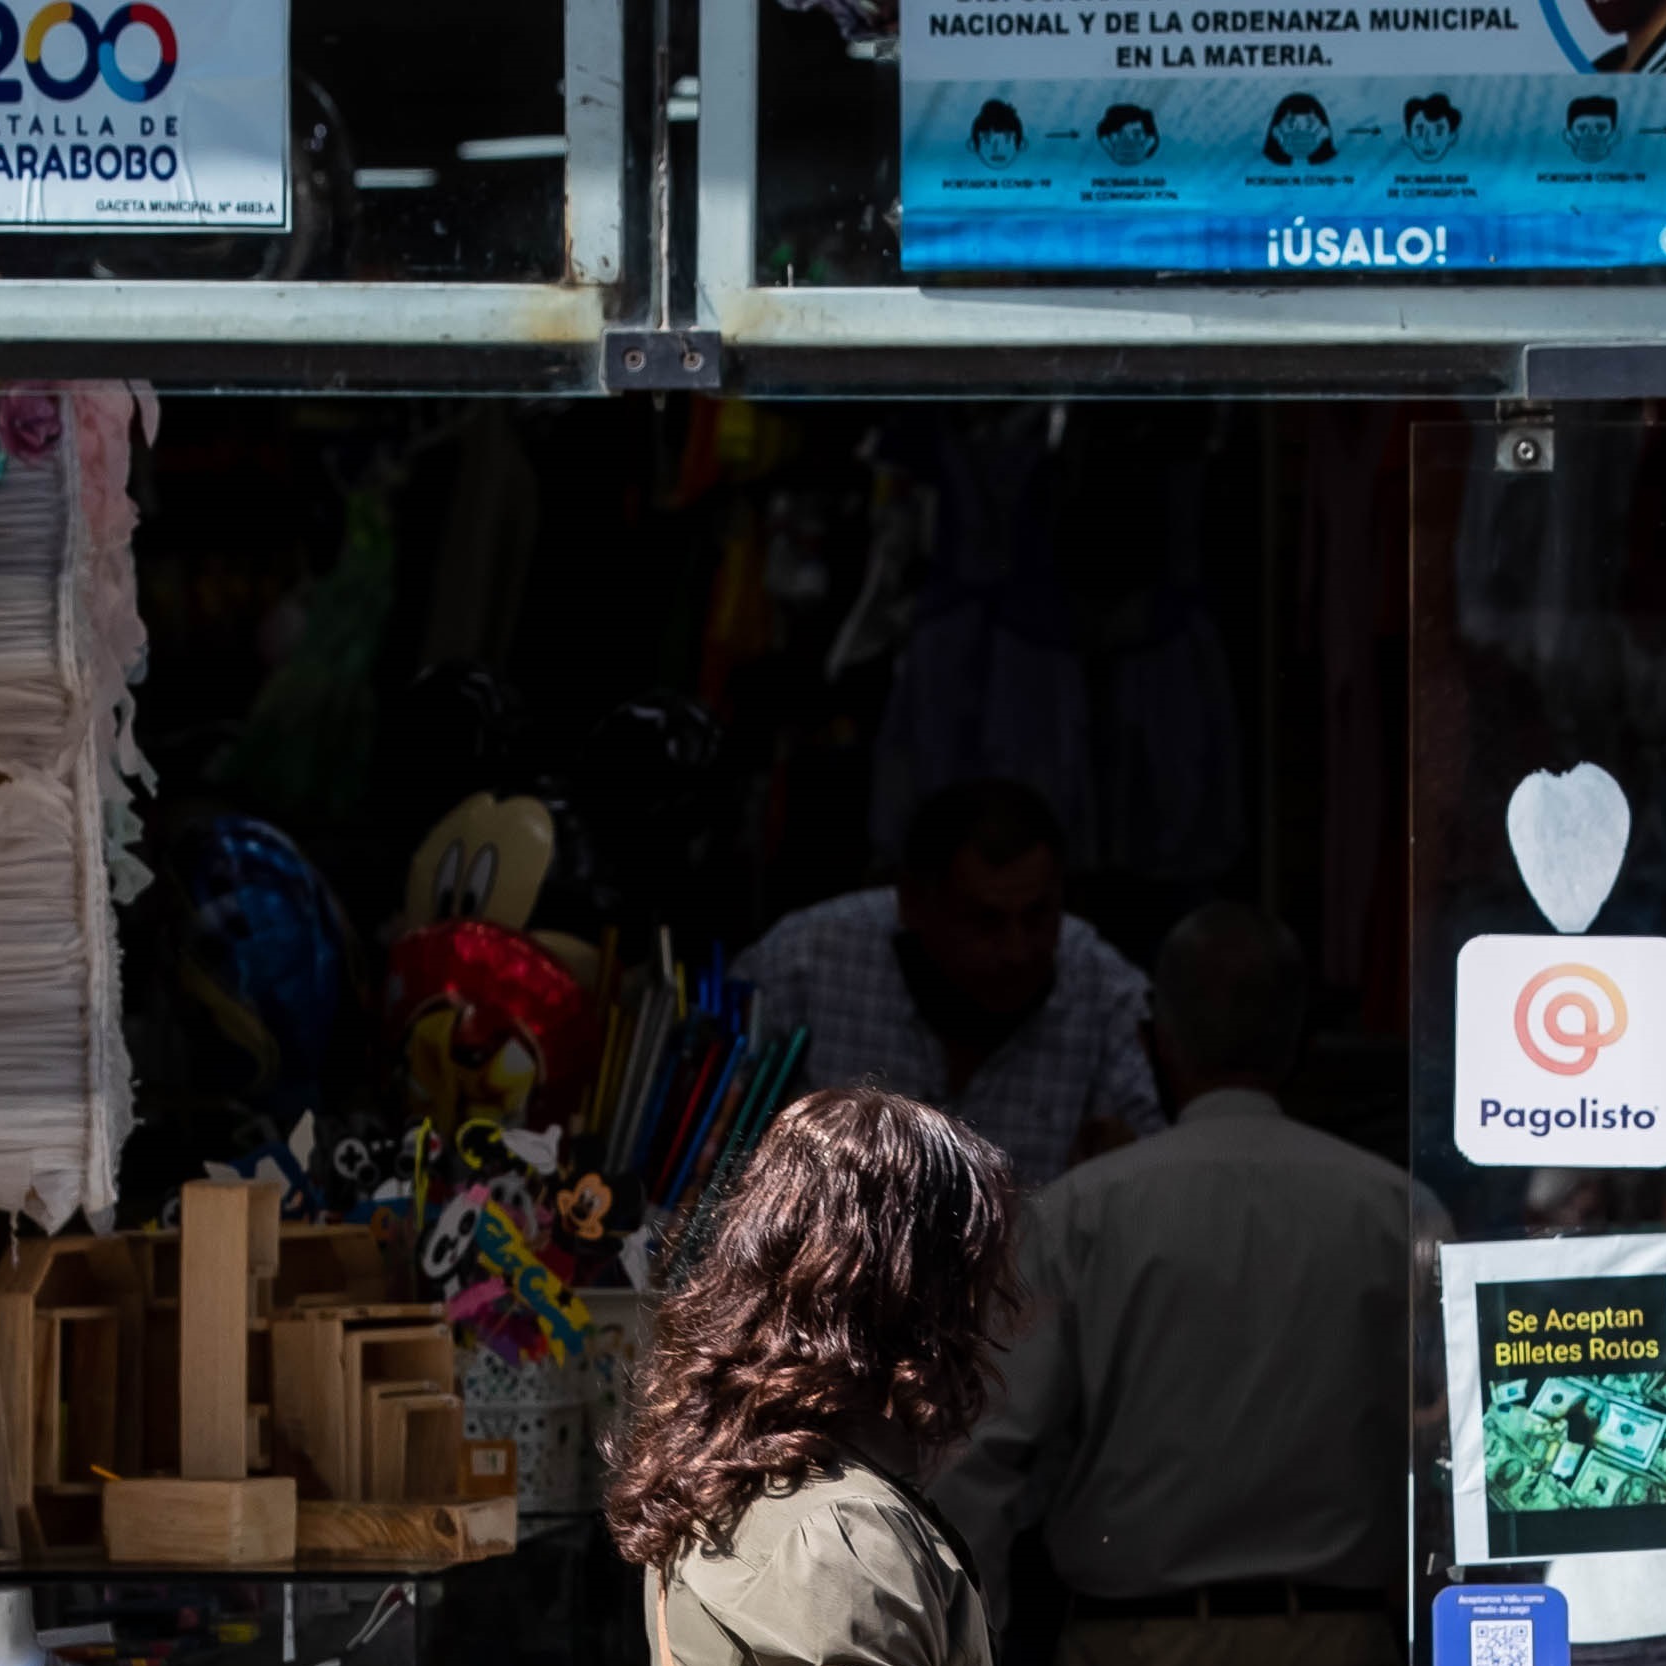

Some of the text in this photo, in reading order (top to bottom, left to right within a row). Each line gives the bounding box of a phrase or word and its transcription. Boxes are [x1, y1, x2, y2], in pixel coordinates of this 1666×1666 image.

[930, 8, 1520, 36] NACIONAL Y DE LA ORDENANZA MUNICIPAL
[1116, 43, 1332, 68] EN LA MATERIA.
[141, 115, 178, 137] DE
[1269, 215, 1446, 266] ¡ÚSALO!
[1480, 1097, 1656, 1137] Pagolisto
[1506, 1305, 1644, 1334] Se Aceptan
[1494, 1337, 1660, 1366] Billetes Rotos
